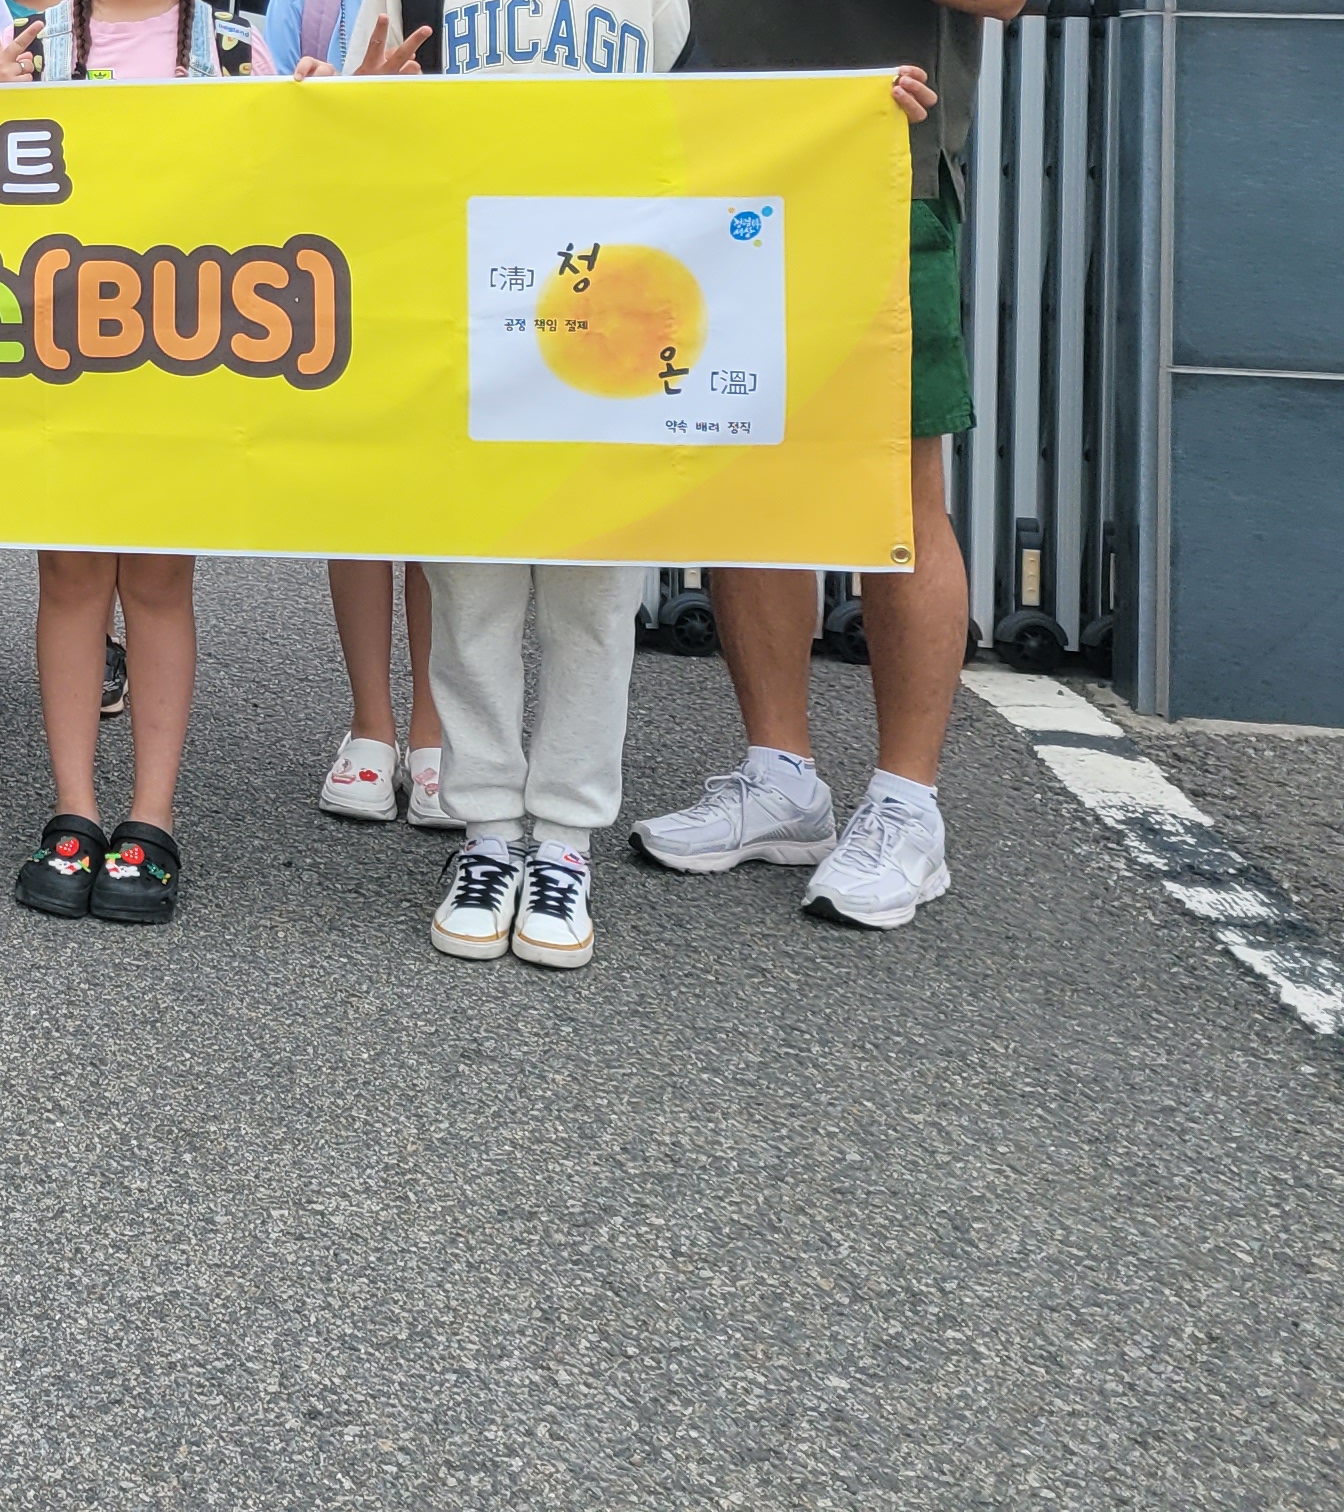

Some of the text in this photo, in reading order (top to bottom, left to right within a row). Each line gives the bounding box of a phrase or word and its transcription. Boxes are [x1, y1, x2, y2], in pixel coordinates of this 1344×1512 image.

[557, 242, 601, 293] 청
[504, 318, 589, 332] 공정 책임 절제
[658, 345, 689, 396] 온
[665, 420, 751, 434] 약속 배려 정직
